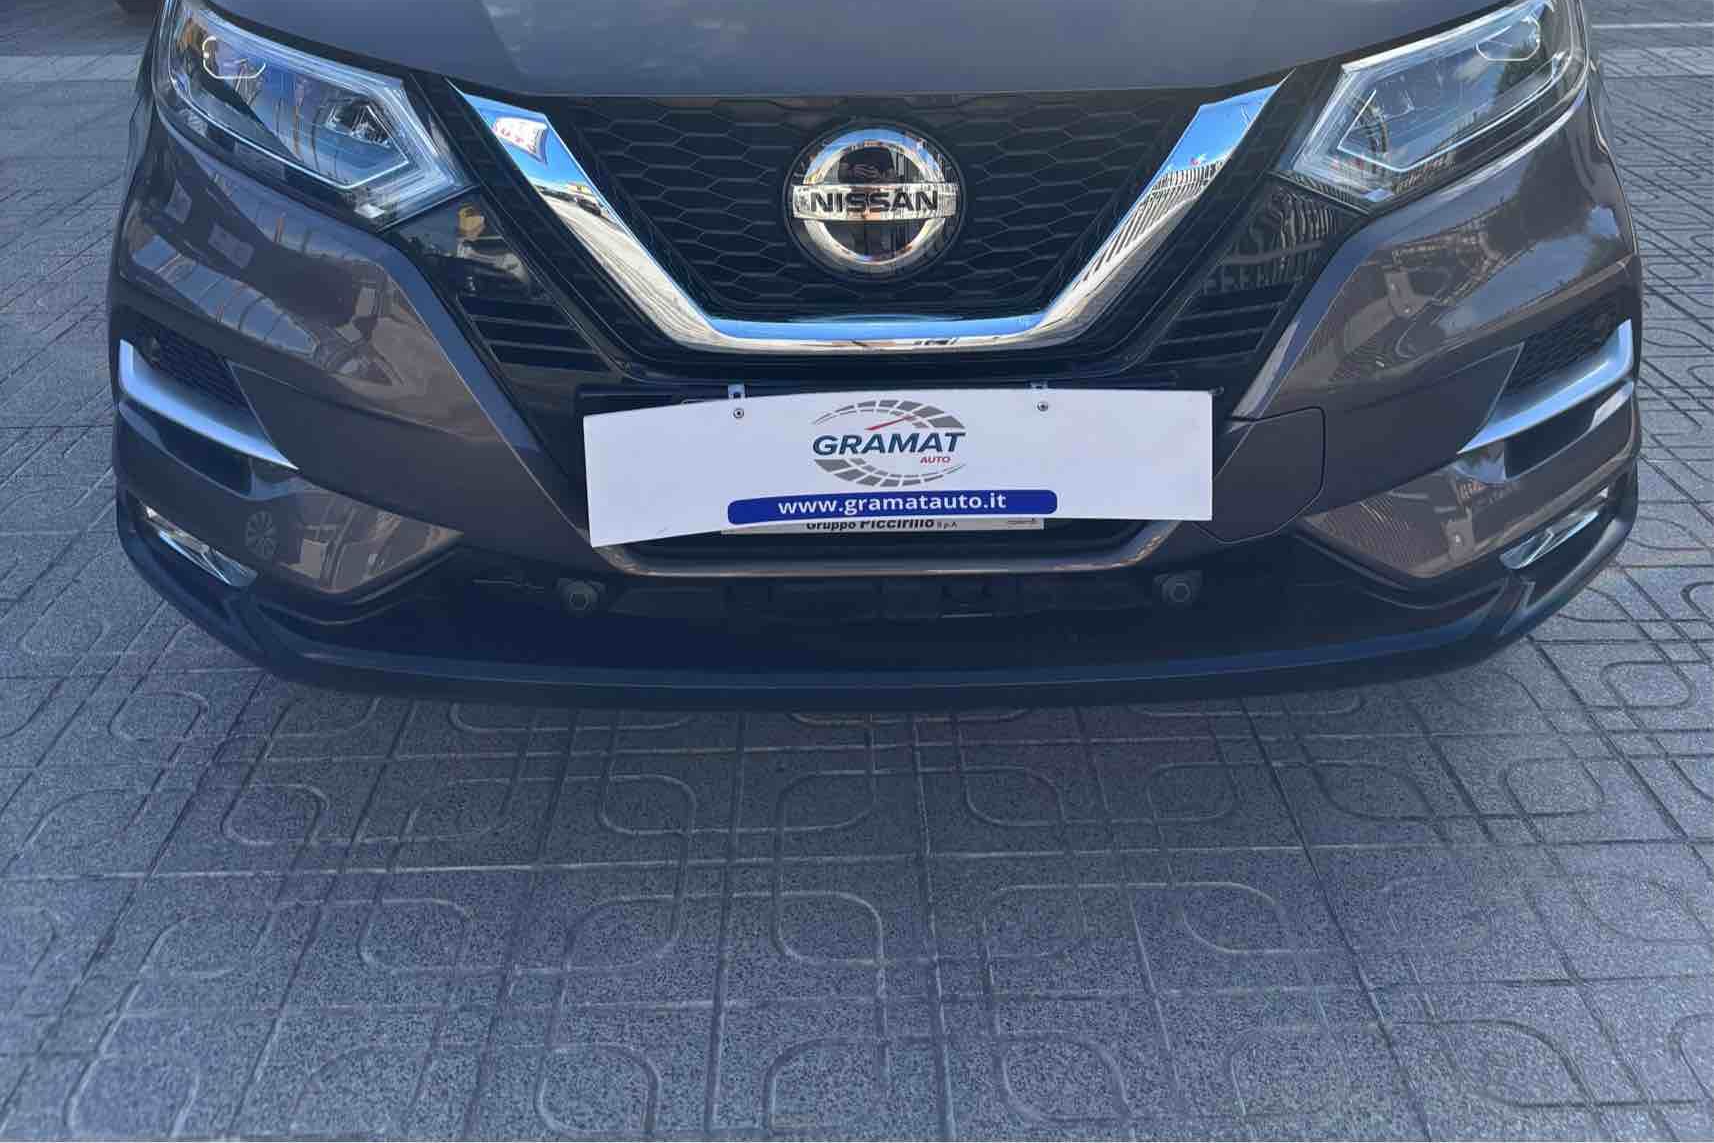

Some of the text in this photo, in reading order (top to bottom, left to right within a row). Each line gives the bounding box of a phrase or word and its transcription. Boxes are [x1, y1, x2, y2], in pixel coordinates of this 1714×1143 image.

[810, 190, 938, 213] NISSAN
[812, 431, 966, 456] GRAMAT
[920, 455, 951, 464] AUTO
[777, 491, 1007, 515] www.gramatauto.it
